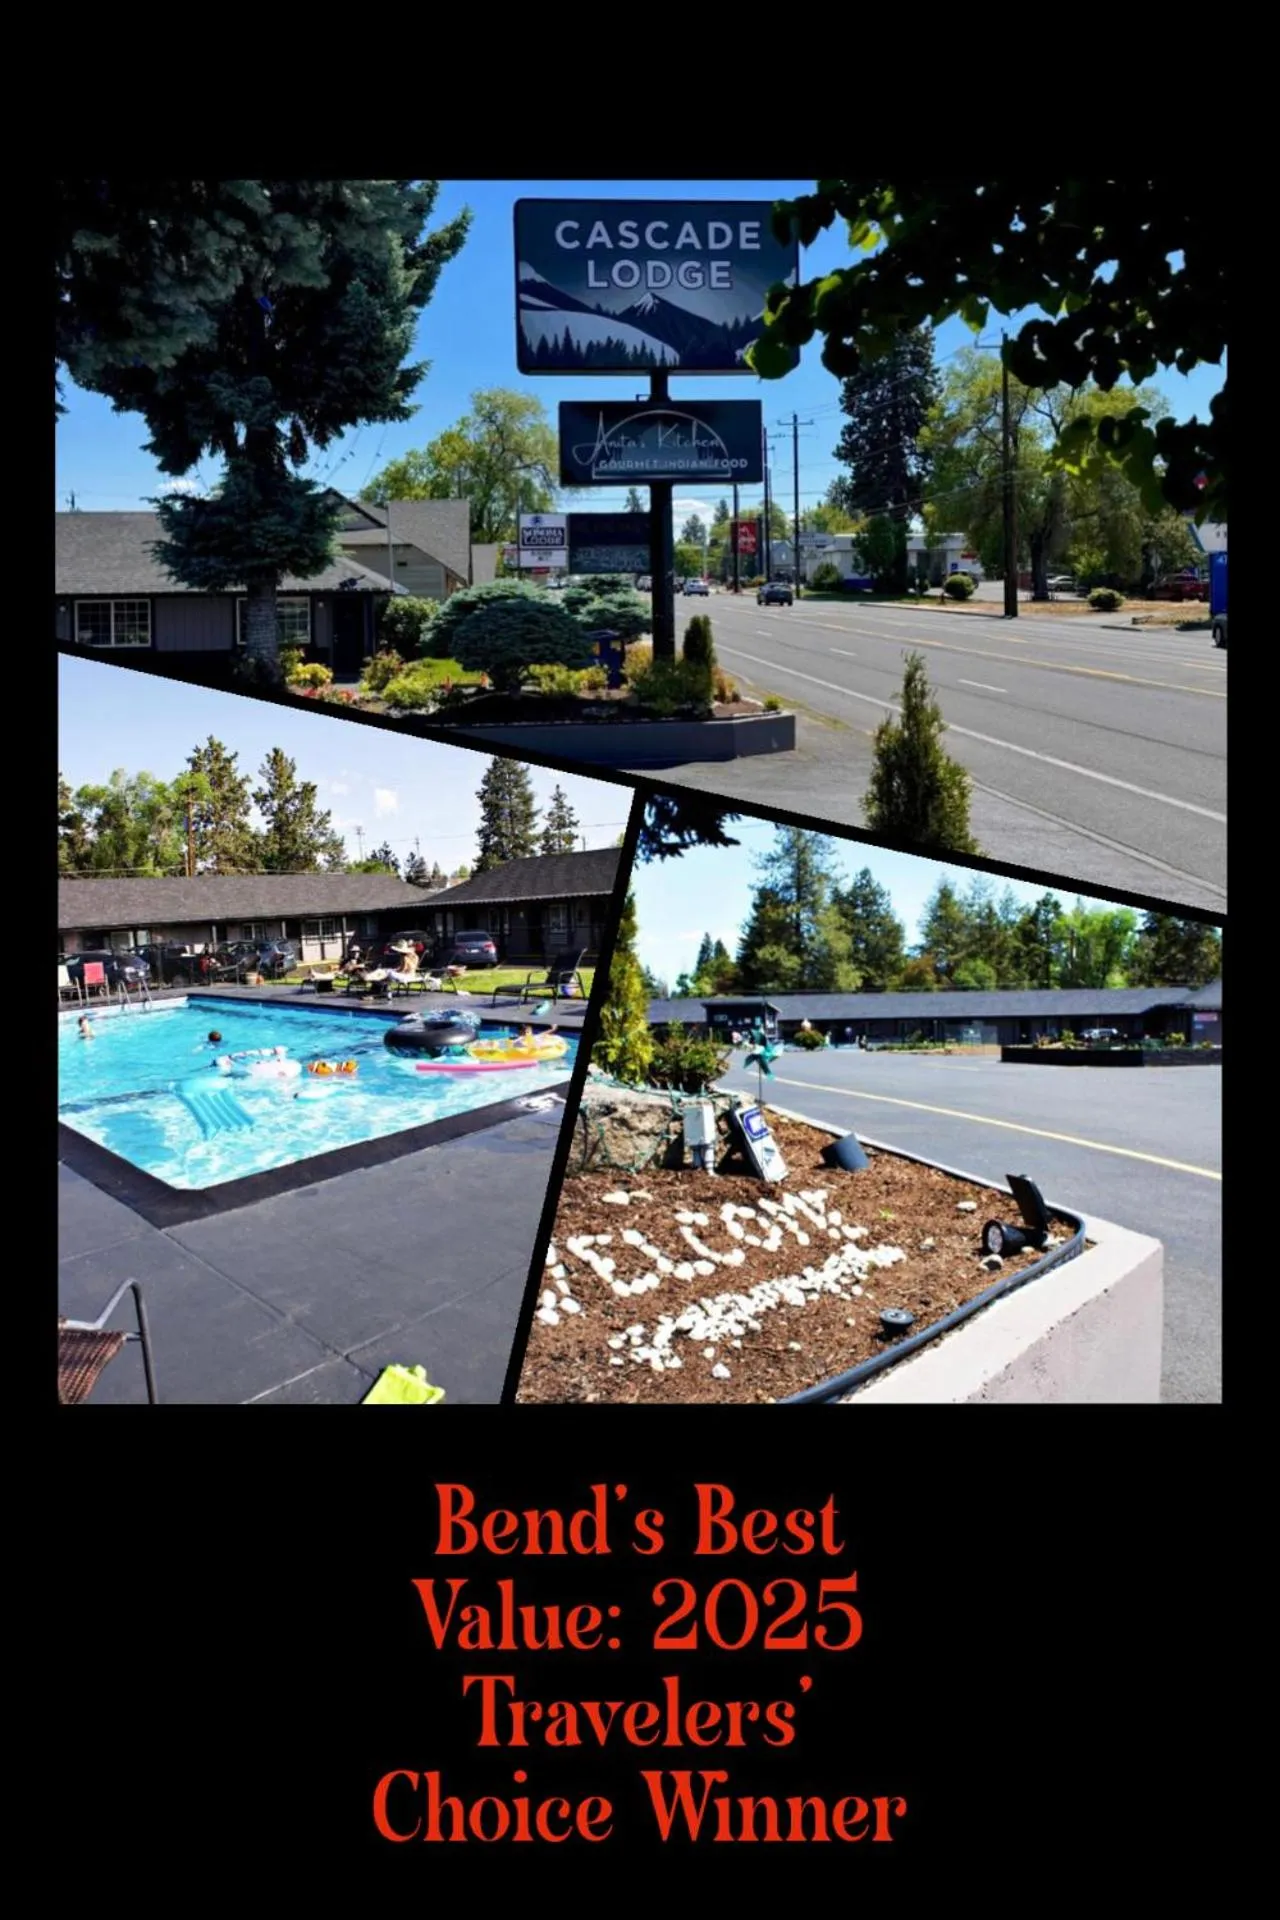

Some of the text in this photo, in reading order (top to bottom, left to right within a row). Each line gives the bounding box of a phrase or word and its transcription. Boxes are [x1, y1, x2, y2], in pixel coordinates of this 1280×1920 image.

[555, 220, 761, 249] CASCADE
[587, 260, 731, 288] LODGE
[657, 419, 722, 449] Kitchen
[599, 457, 748, 469] GOURMET INDIAN FOOD
